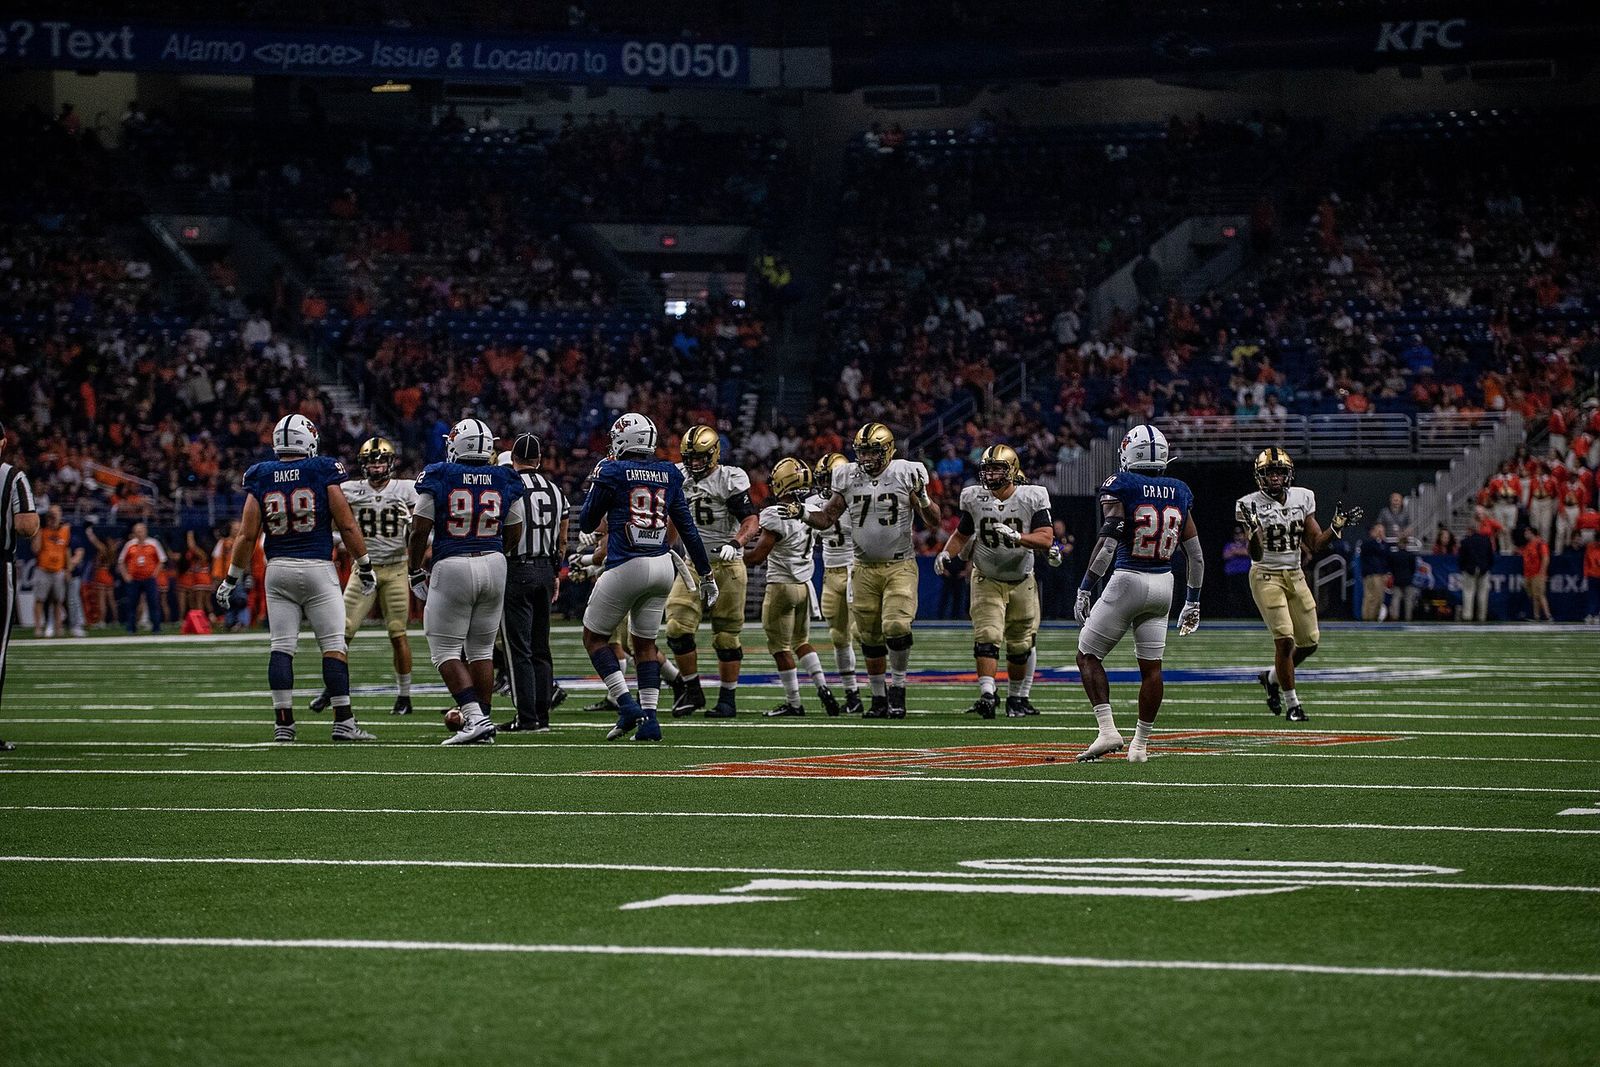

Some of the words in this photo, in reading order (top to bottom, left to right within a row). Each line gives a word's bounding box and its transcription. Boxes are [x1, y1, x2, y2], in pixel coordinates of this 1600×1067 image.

[41, 21, 135, 60] Text
[161, 33, 245, 63] Alamo
[254, 42, 365, 70] <space>
[372, 40, 440, 68] Issue
[446, 42, 465, 68] &
[472, 42, 578, 73] Location
[584, 49, 608, 74] to
[621, 41, 740, 78] 69050
[1375, 18, 1466, 51] KFC
[274, 468, 300, 483] BAKER
[462, 473, 492, 485] NEWTON
[1143, 484, 1176, 500] GRADY
[263, 486, 317, 537] 99
[359, 508, 399, 538] 88
[448, 488, 502, 538] 92
[629, 485, 667, 529] 91
[853, 492, 899, 528] 73
[638, 530, 661, 540] DOUGLAS
[1131, 503, 1182, 560] 28
